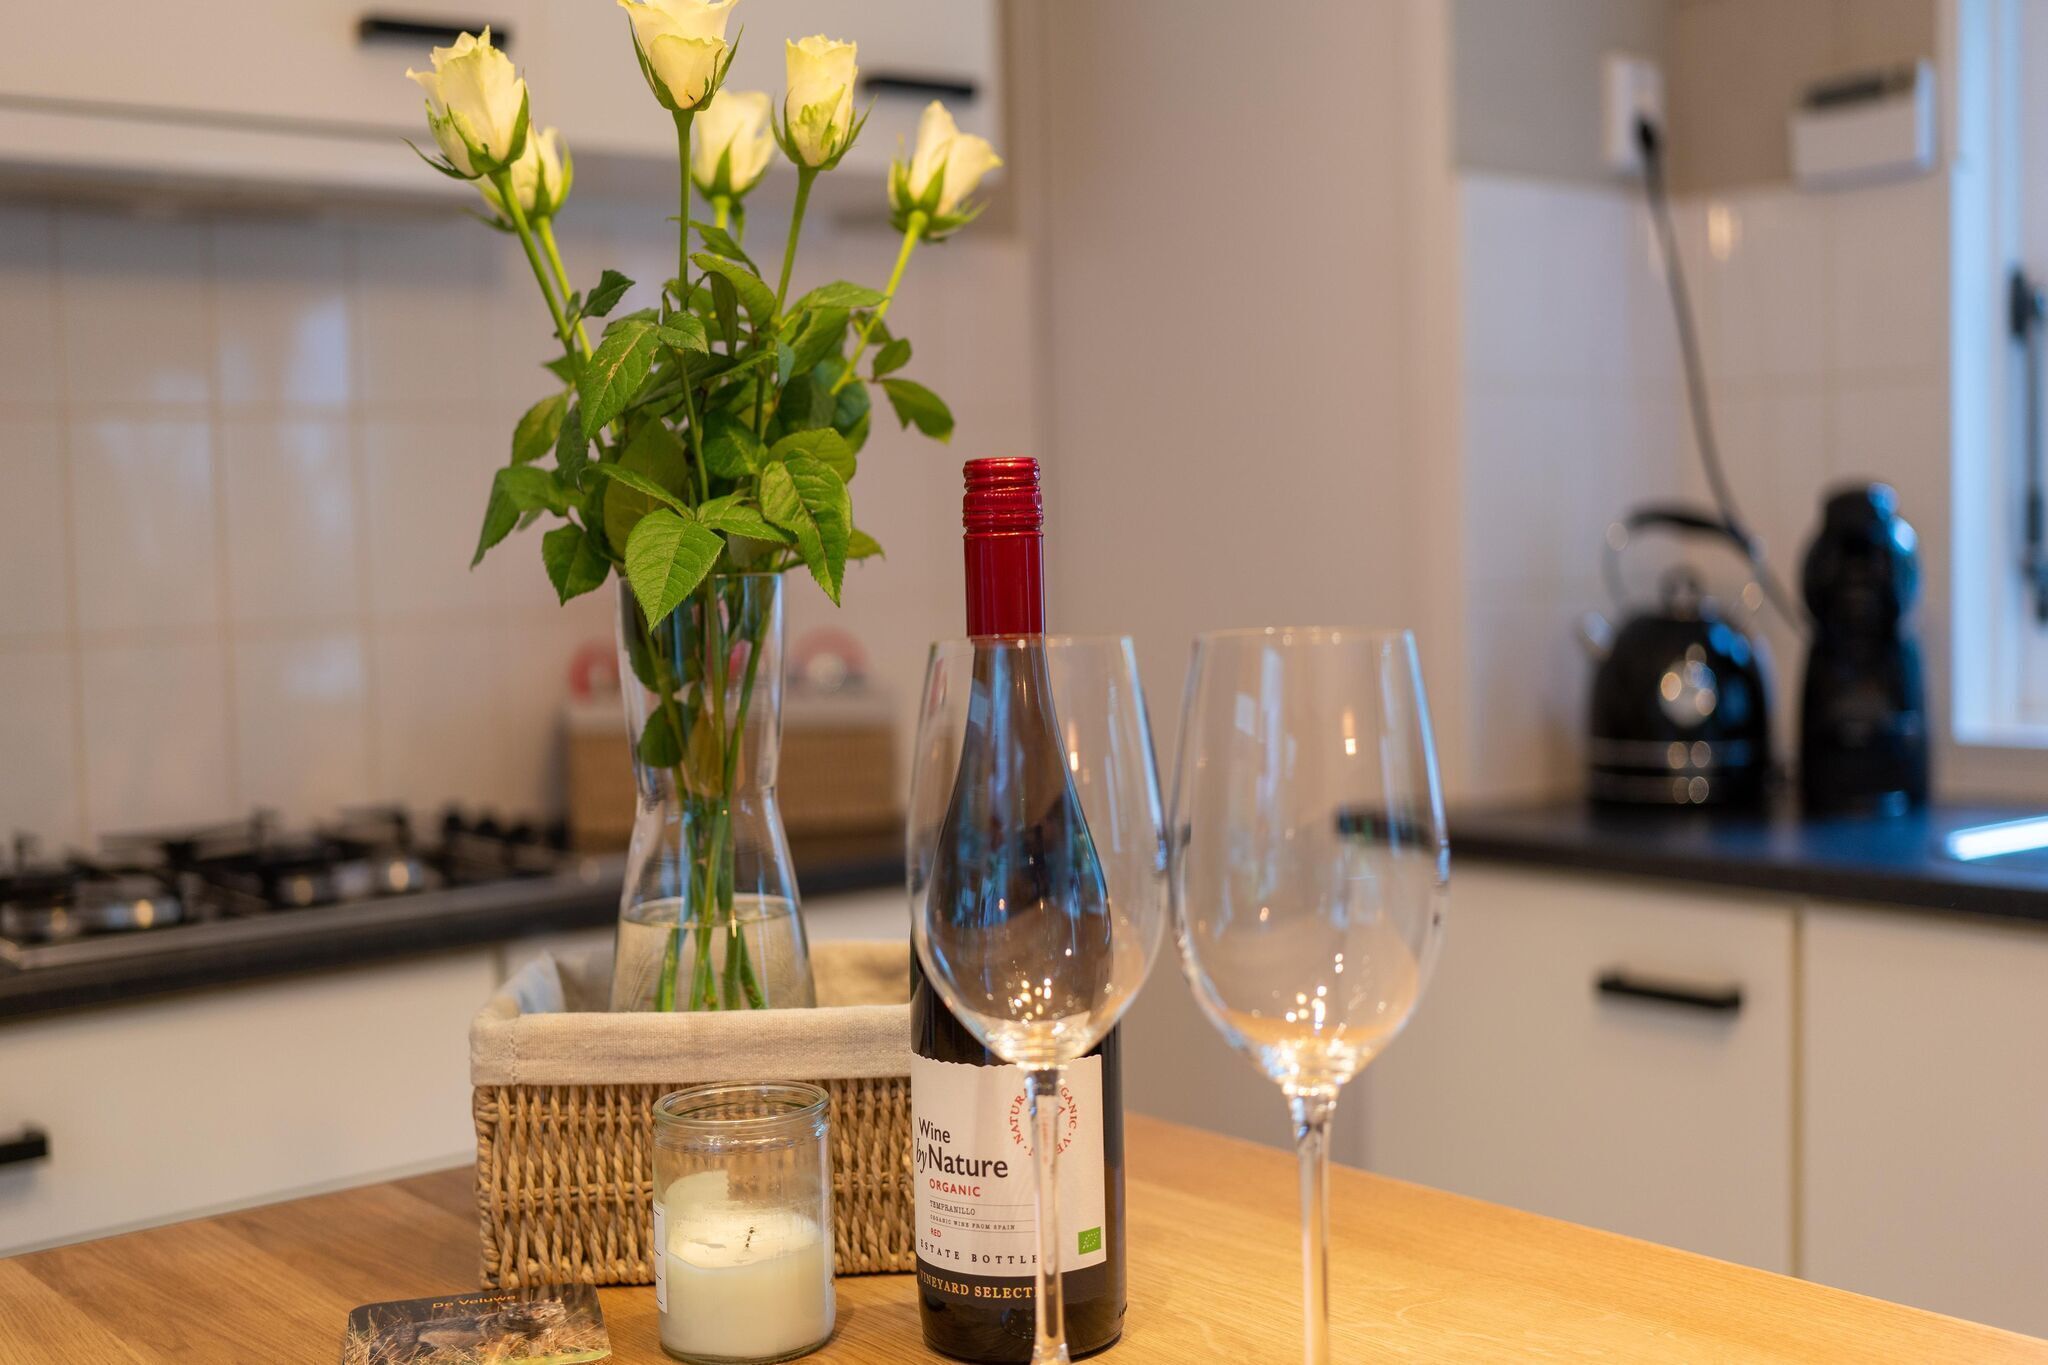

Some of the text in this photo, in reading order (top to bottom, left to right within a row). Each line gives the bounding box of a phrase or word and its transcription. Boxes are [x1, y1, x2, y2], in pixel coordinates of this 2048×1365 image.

[918, 1116, 951, 1144] Wine
[928, 1143, 1008, 1179] Nature
[929, 1178, 981, 1197] ORGANIC
[929, 1199, 976, 1216] TEMPRANILLO
[930, 1214, 952, 1225] ORGANIC
[953, 1219, 969, 1228] WINE
[972, 1222, 991, 1230] FROM
[930, 1227, 942, 1238] RED
[920, 1238, 1037, 1265] ESTATE BOTTLE
[919, 1268, 1037, 1299] VINEYARD SELECT
